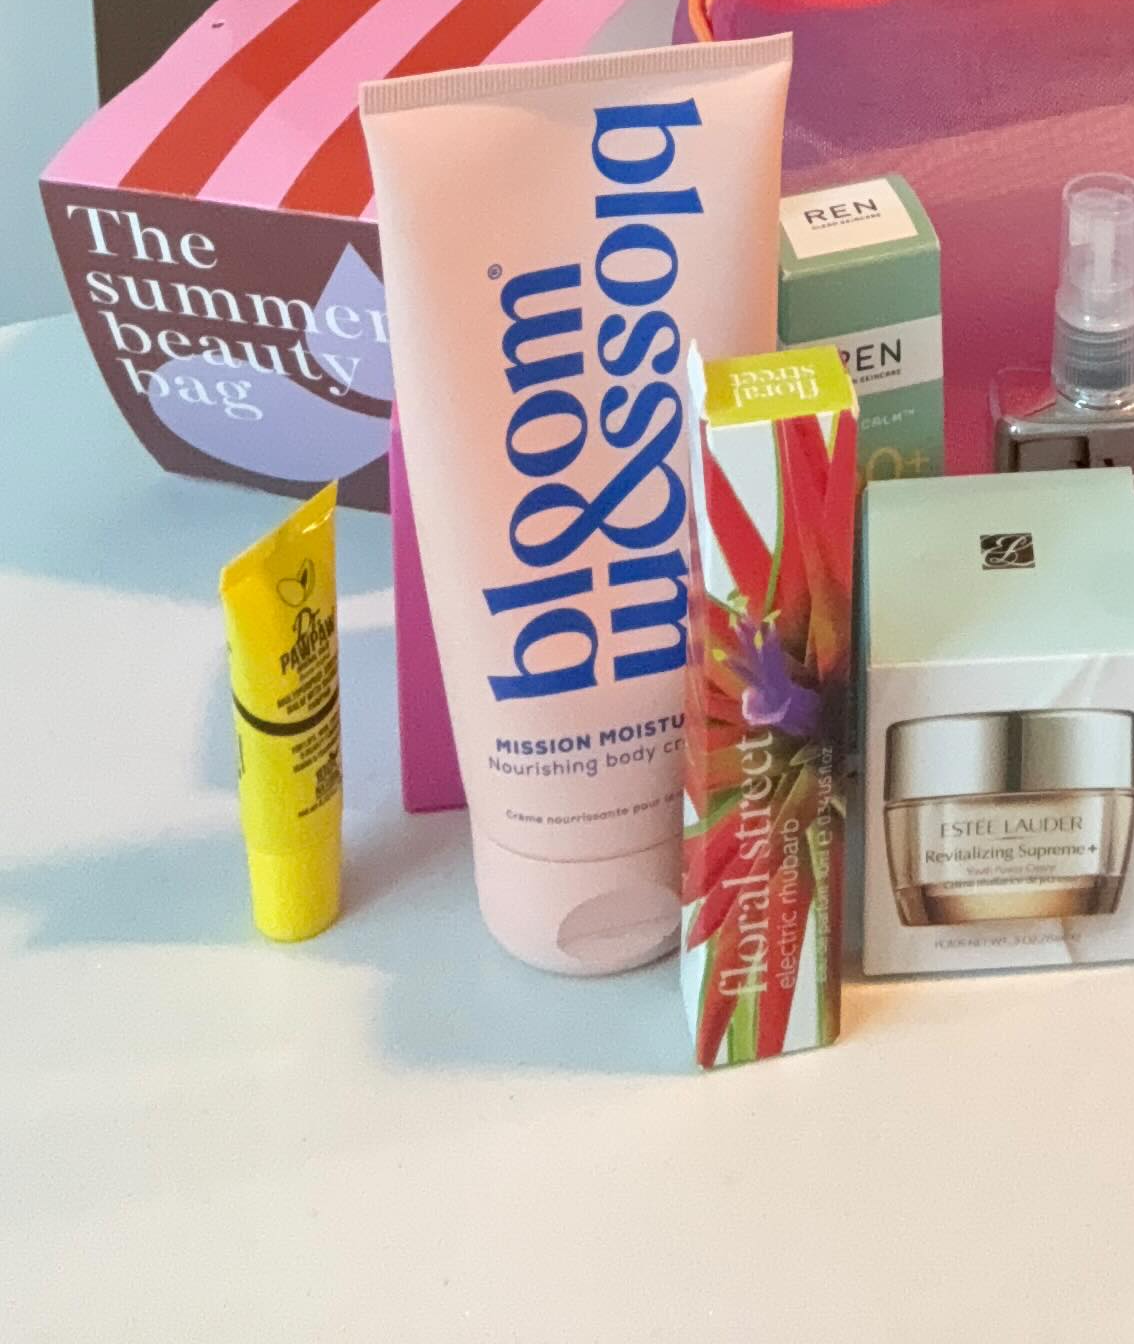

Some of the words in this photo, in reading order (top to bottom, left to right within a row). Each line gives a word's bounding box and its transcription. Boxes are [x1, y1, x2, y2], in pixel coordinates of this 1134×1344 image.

[803, 197, 879, 226] REN
[66, 203, 219, 269] The
[87, 268, 392, 344] summer
[98, 311, 362, 397] beauty
[728, 364, 817, 387] street
[116, 358, 264, 421] bag
[732, 377, 820, 409] floral
[487, 755, 598, 778] Nourishing
[605, 744, 656, 769] body
[495, 732, 592, 756] MISSION
[546, 806, 629, 826] nourrissante
[735, 730, 774, 860] street
[1004, 814, 1084, 834] LAUDER
[778, 818, 801, 905] rhubarb
[924, 845, 1015, 864] Revitalizing
[718, 871, 771, 997] floral
[776, 910, 798, 990] electric
